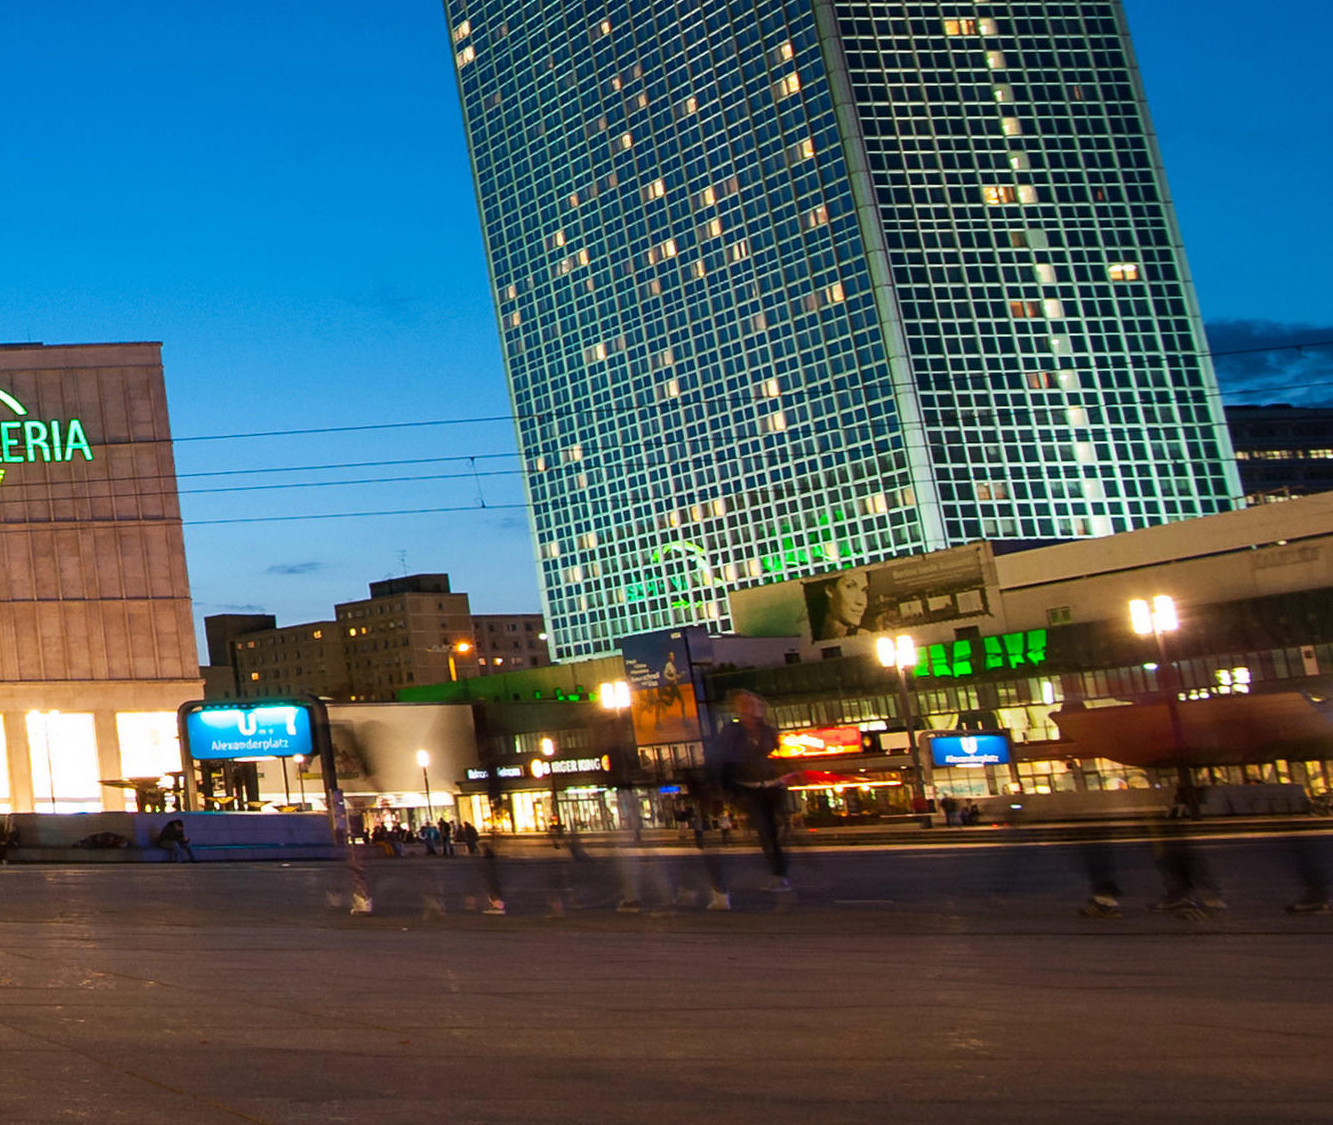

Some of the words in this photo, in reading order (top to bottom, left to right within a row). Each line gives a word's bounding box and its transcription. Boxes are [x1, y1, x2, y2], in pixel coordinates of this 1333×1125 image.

[211, 738, 290, 751] Alexanderplatz
[959, 737, 978, 755] U
[541, 760, 577, 775] BRGER
[577, 758, 602, 772] KING
